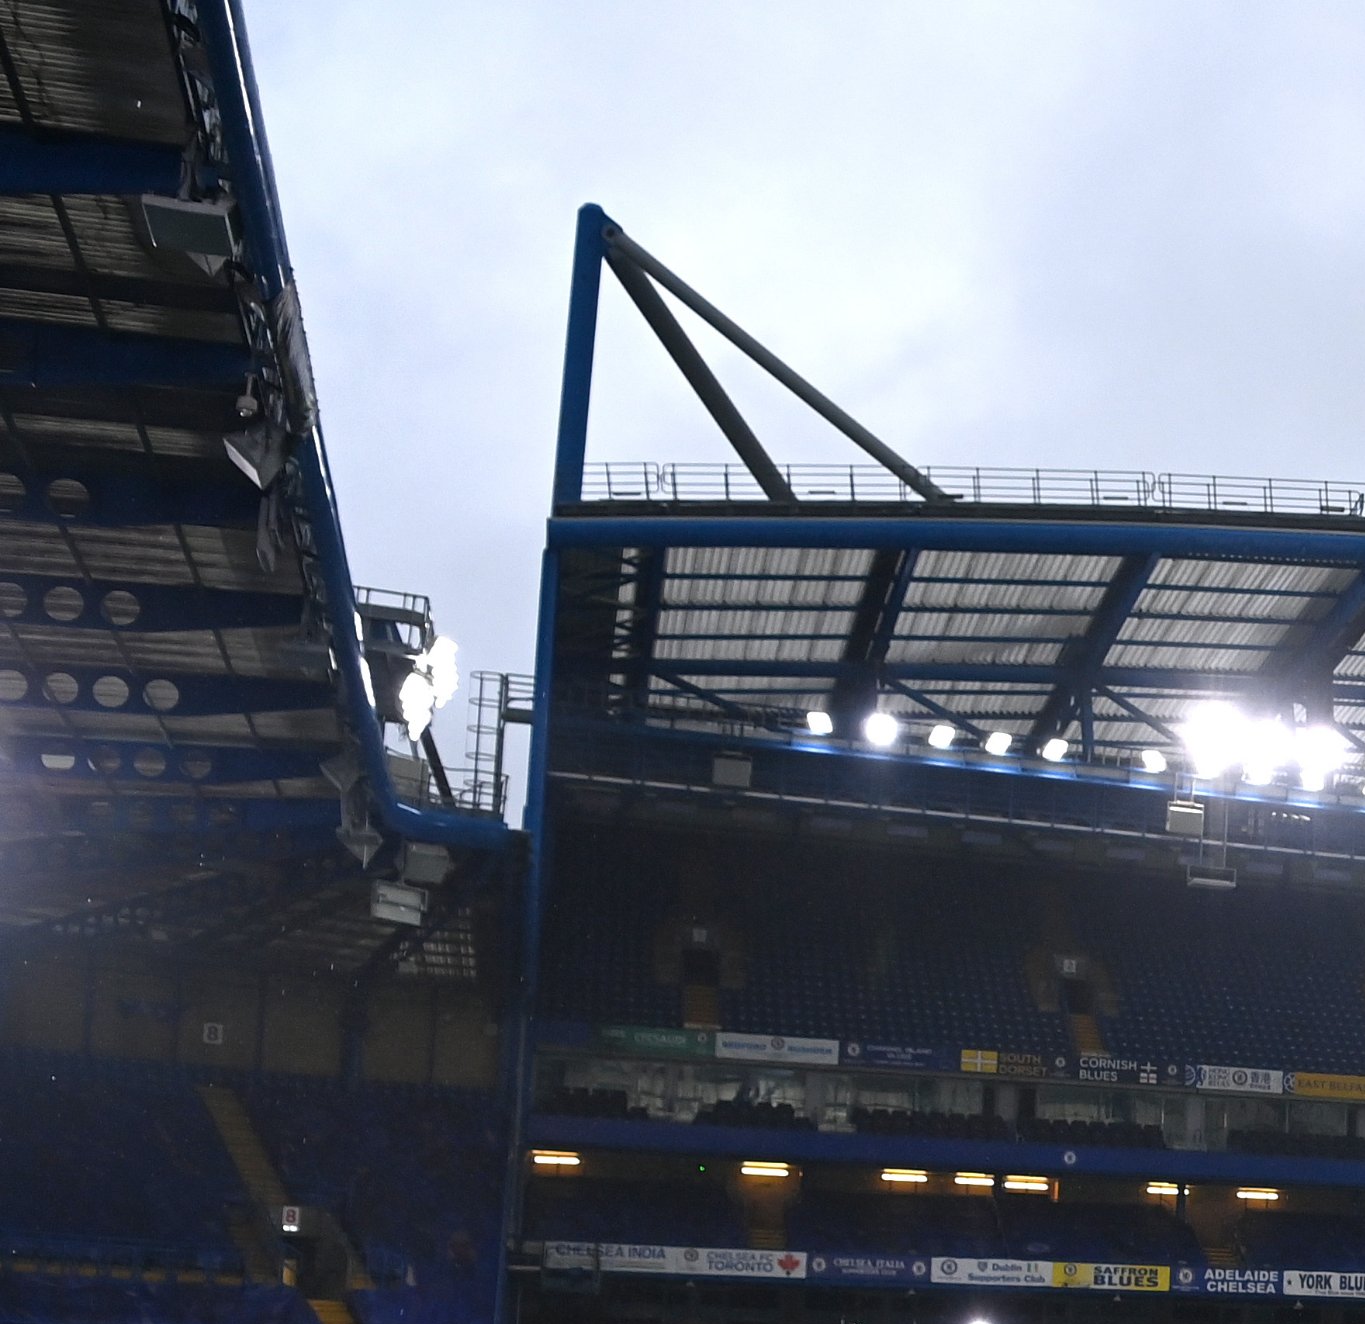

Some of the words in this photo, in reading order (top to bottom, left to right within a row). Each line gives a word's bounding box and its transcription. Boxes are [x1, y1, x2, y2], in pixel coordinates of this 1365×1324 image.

[1000, 1052, 1041, 1064] SOUTH
[1079, 1057, 1138, 1071] CORNISH
[1000, 1064, 1048, 1076] DORSET
[1079, 1068, 1118, 1082] BLUES
[1298, 1077, 1326, 1089] EAST
[556, 1244, 624, 1257] CHELSEA
[628, 1247, 666, 1260] INDIA
[707, 1251, 757, 1262] CHELSEA
[760, 1254, 773, 1263] FC
[707, 1260, 774, 1273] TORONTO
[992, 1262, 1022, 1272] Dublin
[1094, 1266, 1158, 1276] SAFFRON
[968, 1272, 1021, 1284] Supporters
[1024, 1274, 1045, 1283] Club
[1094, 1275, 1159, 1288] BLUES
[1204, 1268, 1280, 1282] ADELAIDE
[1299, 1273, 1332, 1289] YORK
[1206, 1281, 1276, 1294] CHELSEA
